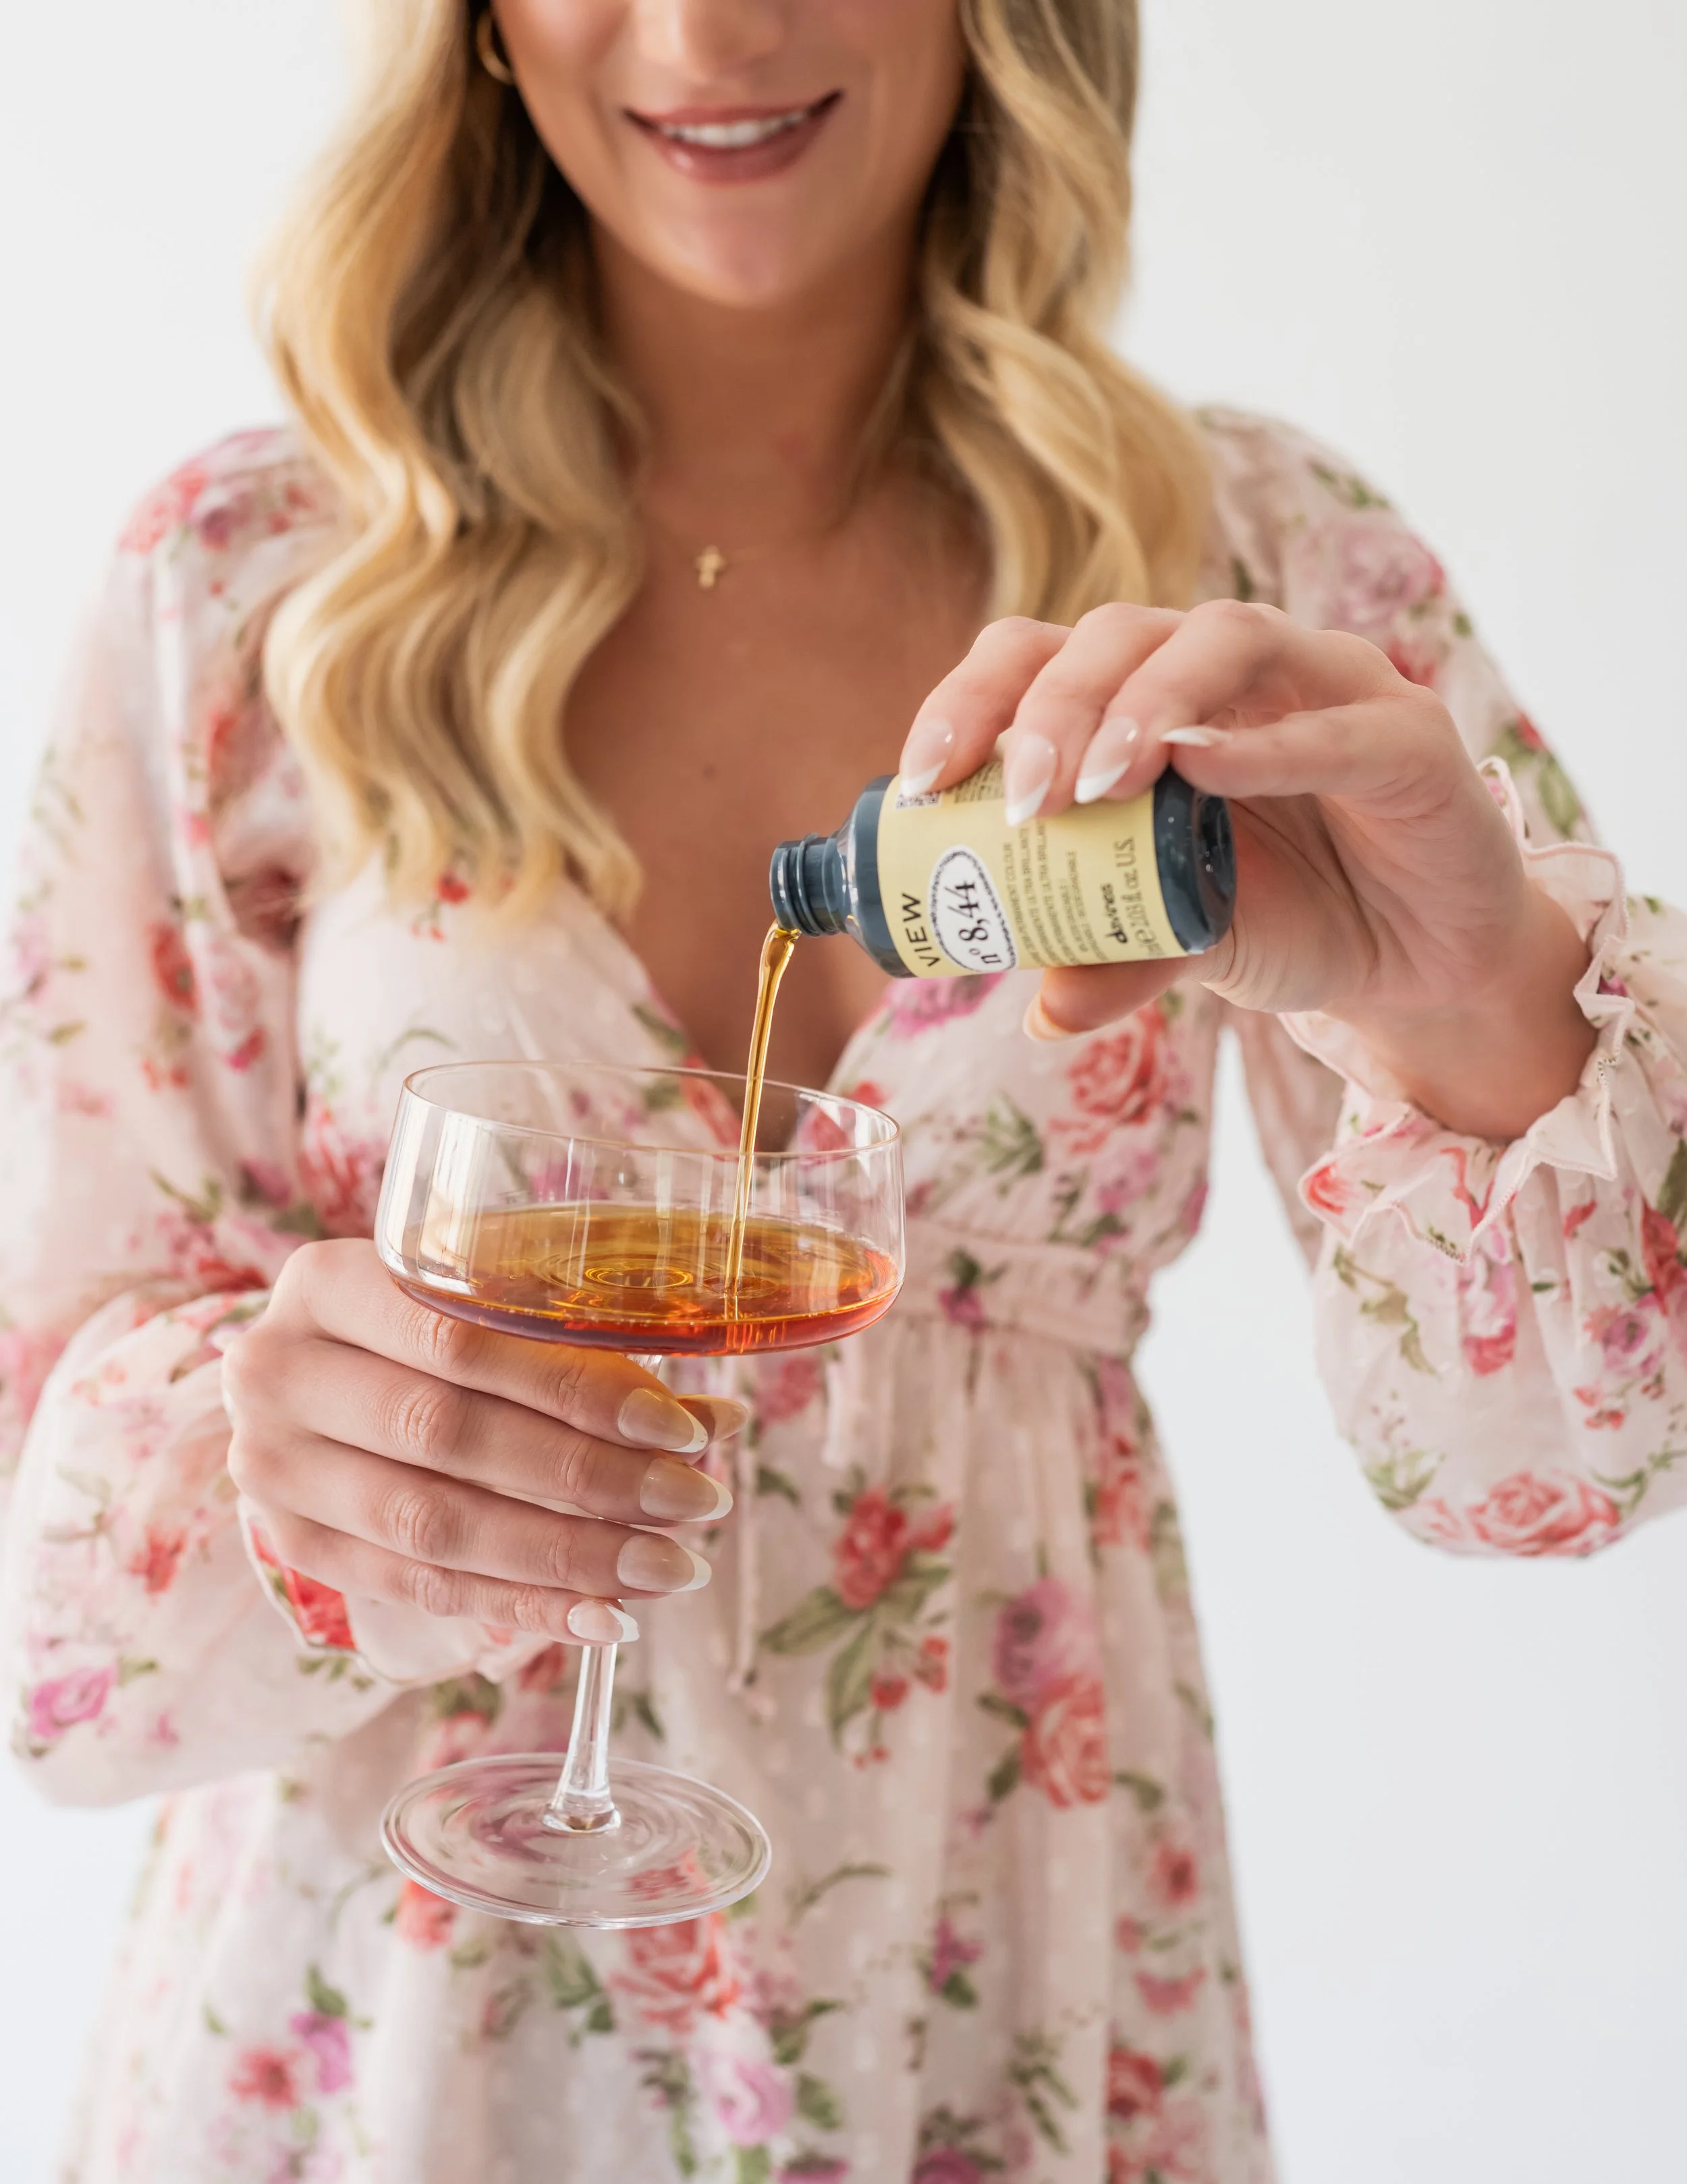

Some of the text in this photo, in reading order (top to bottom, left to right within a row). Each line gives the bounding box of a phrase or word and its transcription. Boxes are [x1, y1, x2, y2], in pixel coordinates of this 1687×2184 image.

[902, 893, 941, 967] VIEW
[945, 880, 991, 942] 8,44
[1100, 883, 1128, 943] davines
